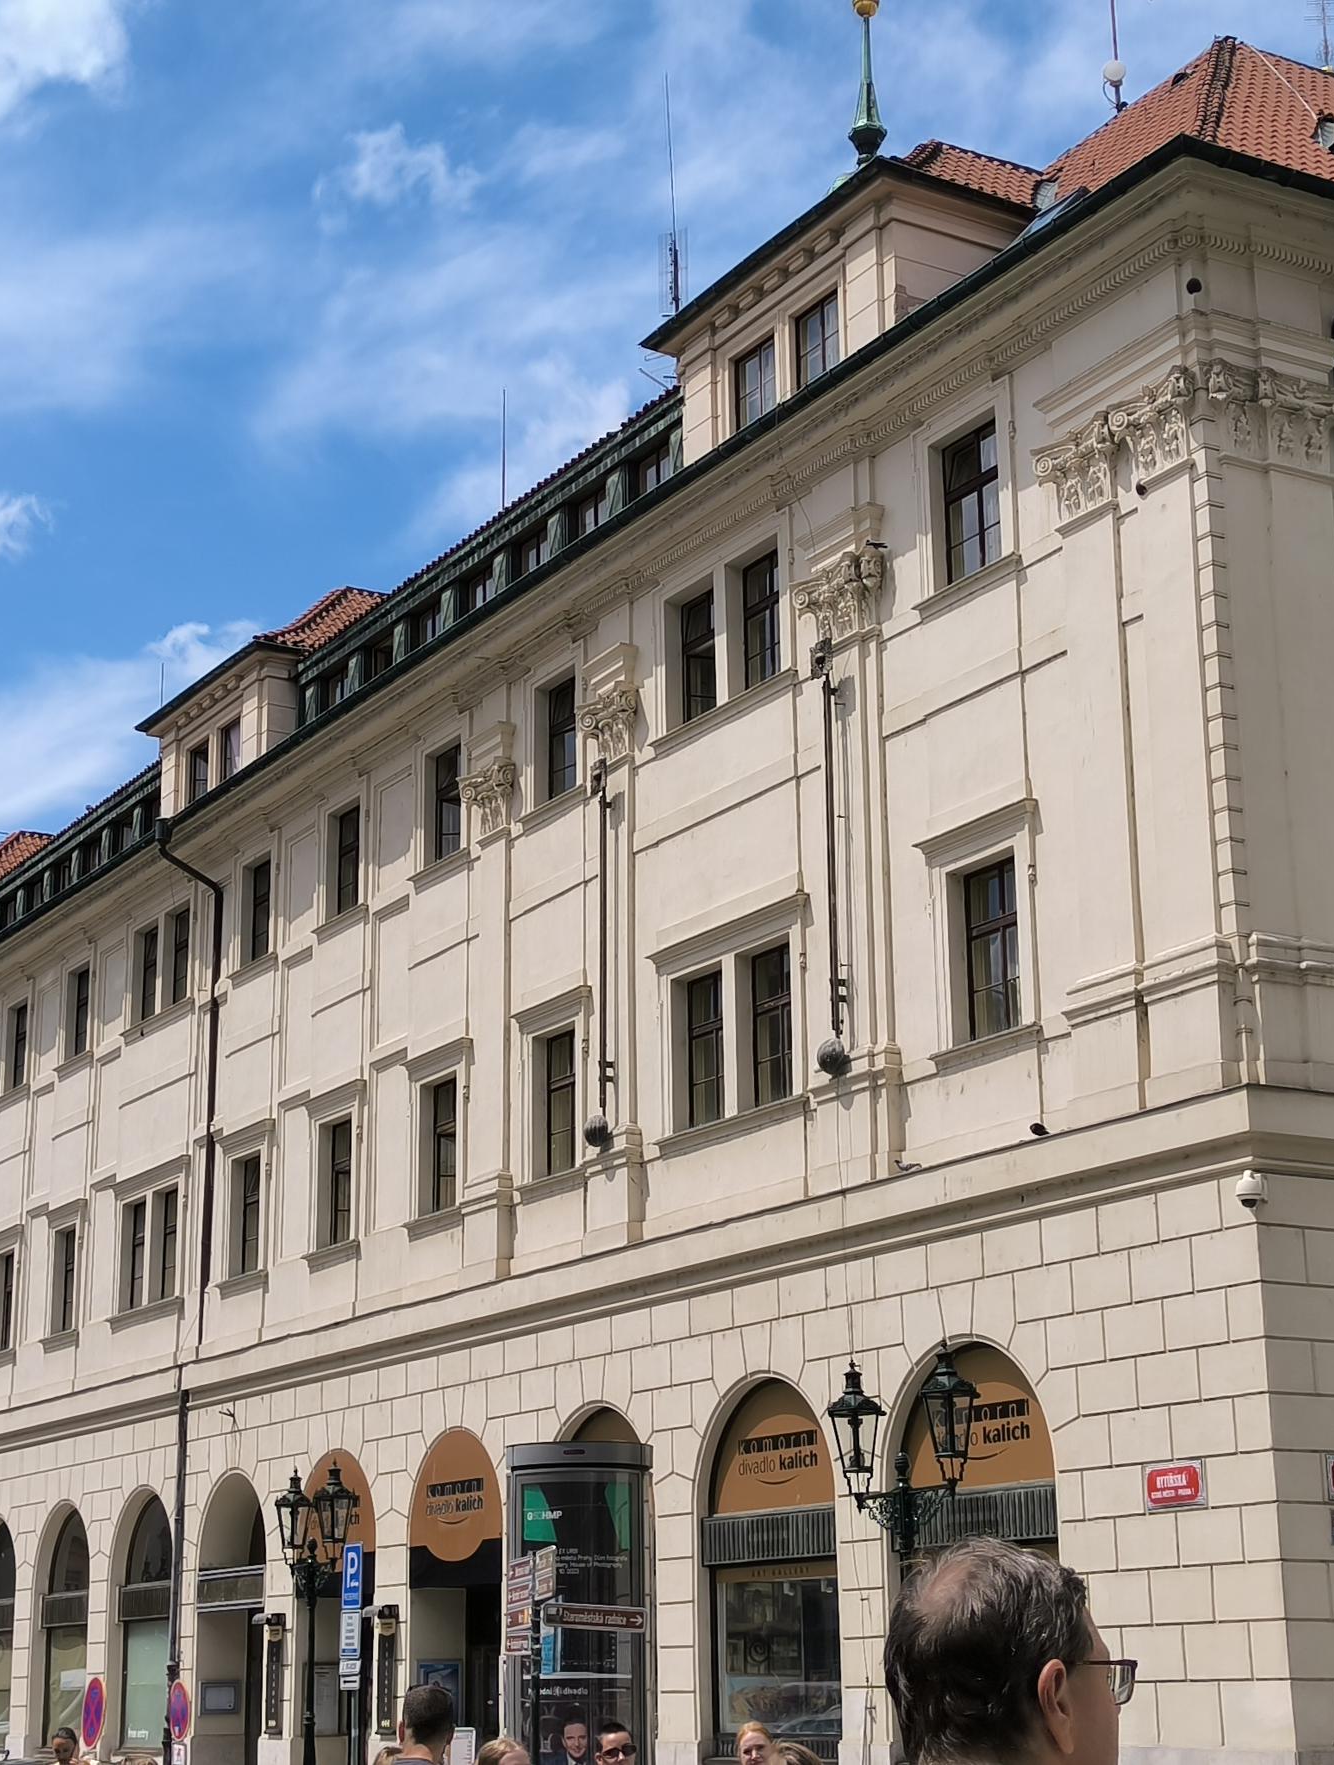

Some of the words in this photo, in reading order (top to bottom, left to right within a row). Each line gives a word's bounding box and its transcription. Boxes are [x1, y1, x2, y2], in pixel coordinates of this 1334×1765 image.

[983, 1421, 1030, 1444] kalich
[738, 1457, 775, 1476] divadlo
[779, 1451, 817, 1471] kalich
[456, 1495, 483, 1512] kalich
